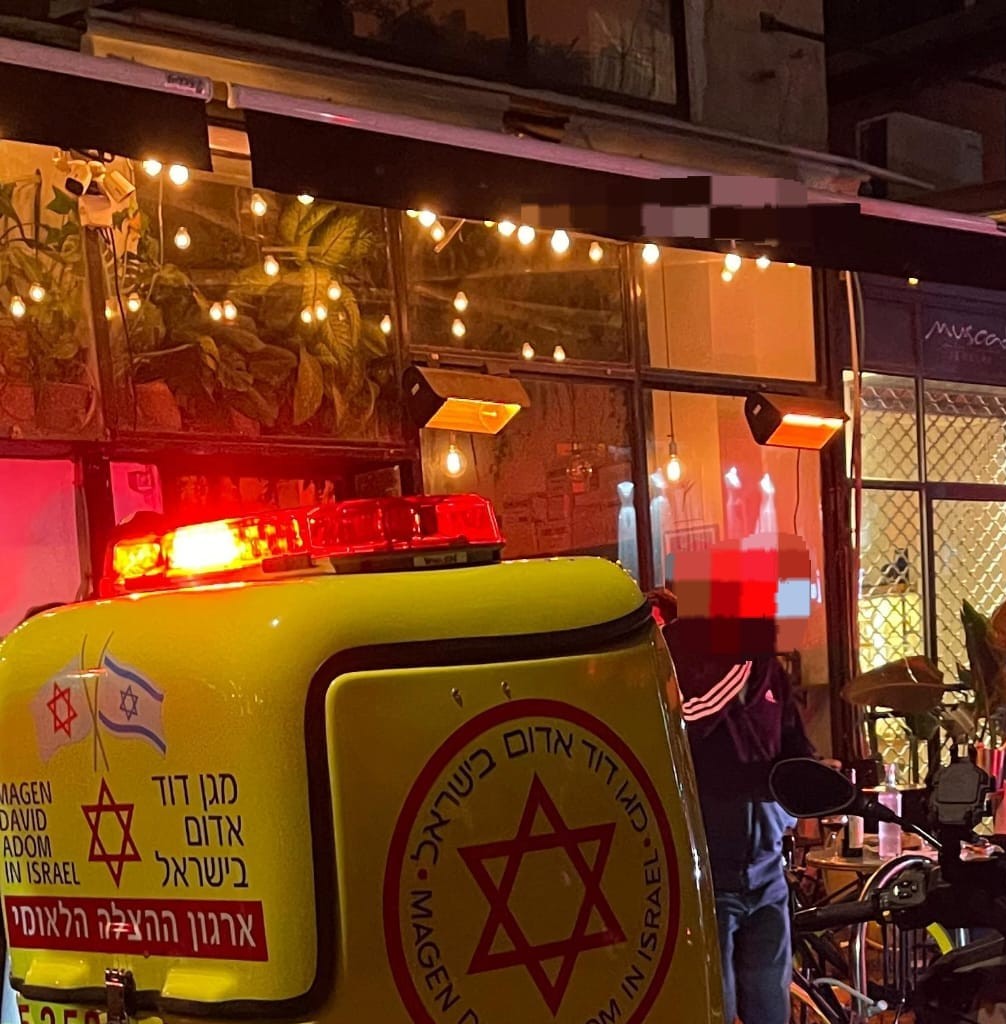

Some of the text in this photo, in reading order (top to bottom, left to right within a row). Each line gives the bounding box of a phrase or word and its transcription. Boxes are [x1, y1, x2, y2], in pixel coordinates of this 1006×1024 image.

[152, 773, 239, 811] מגן דוד
[410, 726, 649, 867] מגן דוד אדום בישראל
[0, 808, 48, 832] DAVID
[184, 815, 244, 847] אדום
[3, 835, 52, 858] ADOM
[5, 861, 81, 886] IN ISRAEL
[155, 851, 249, 888] בישראל
[12, 900, 256, 953] ארגון ההצלה הלאומי
[411, 889, 462, 1013] MAGEN
[621, 964, 645, 1000] IN
[639, 847, 662, 962] ISRAEL
